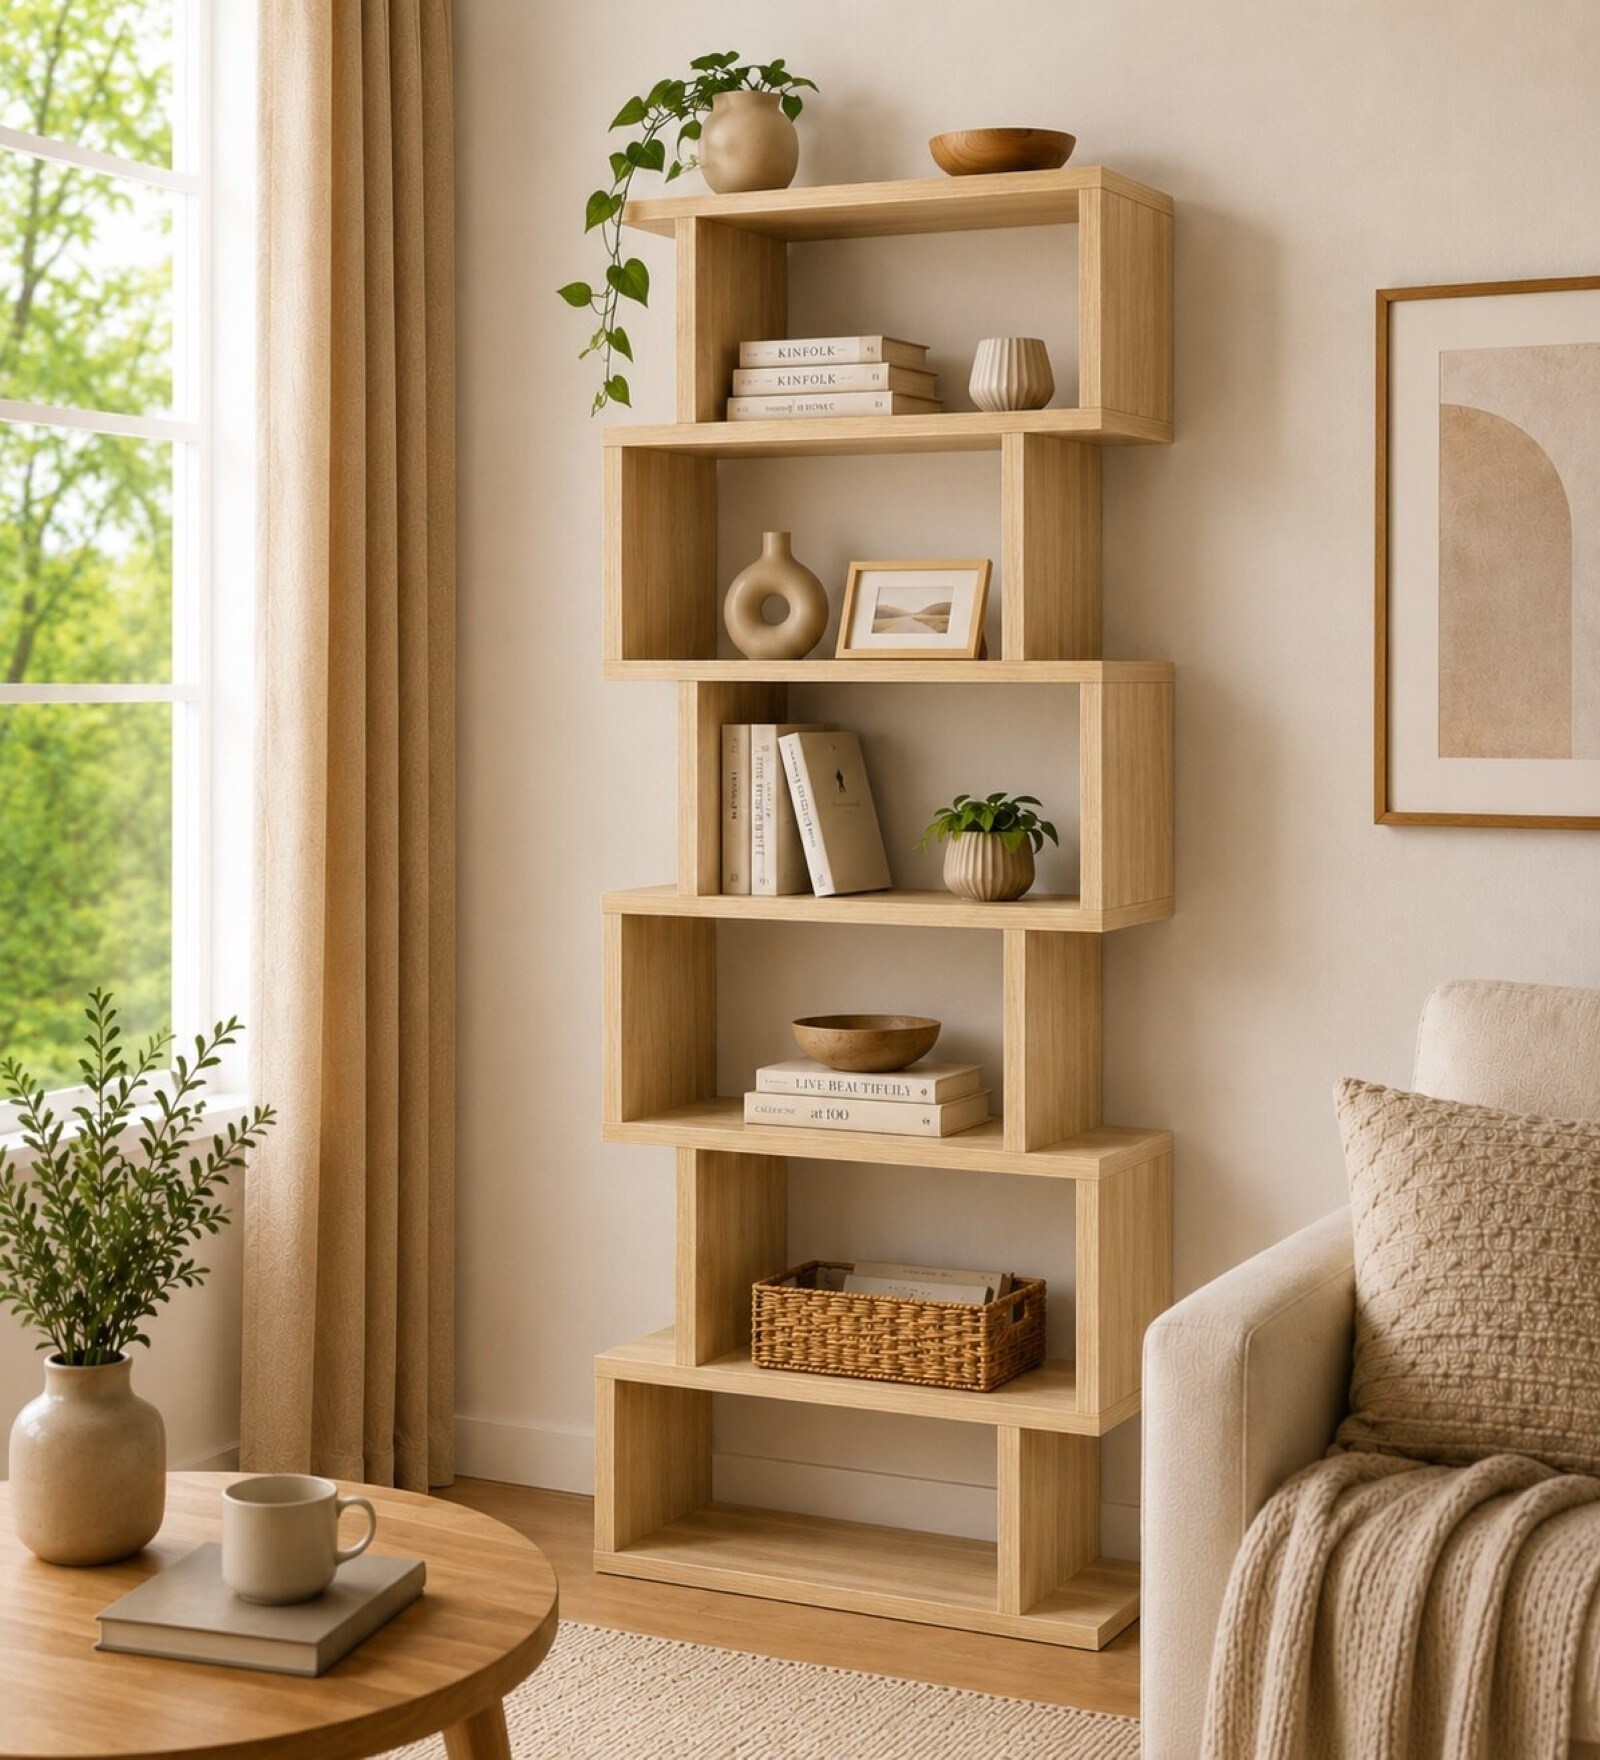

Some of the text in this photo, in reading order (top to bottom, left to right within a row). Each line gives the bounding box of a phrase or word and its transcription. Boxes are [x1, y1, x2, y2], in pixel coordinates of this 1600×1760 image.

[778, 345, 835, 358] KINFOLK
[778, 373, 836, 386] KINFOLK
[795, 1078, 824, 1091] LIVE
[810, 1108, 823, 1120] at
